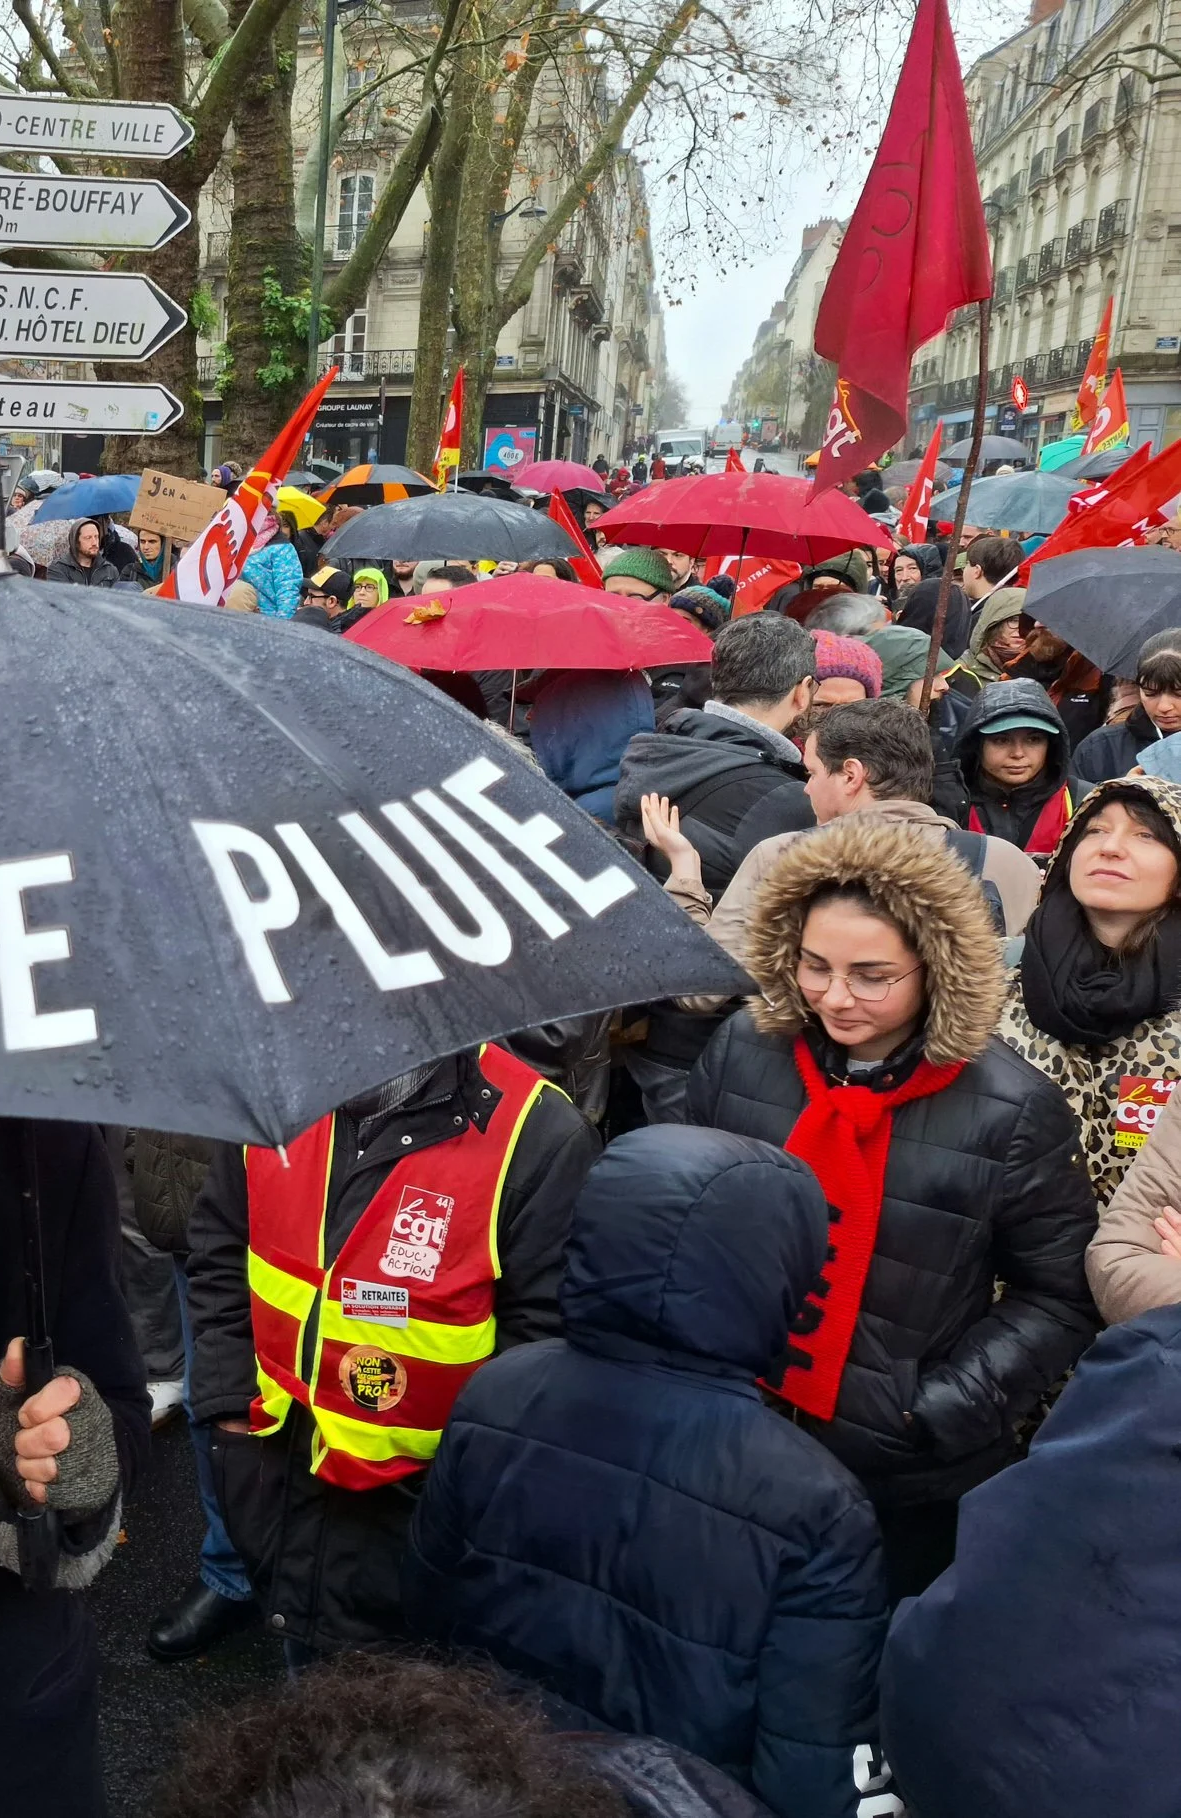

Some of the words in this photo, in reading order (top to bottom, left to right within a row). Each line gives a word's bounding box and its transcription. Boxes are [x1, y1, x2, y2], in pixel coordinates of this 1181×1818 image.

[111, 121, 165, 144] VILLE
[16, 314, 86, 344] HÔTEL
[93, 323, 145, 345] DIEU
[190, 756, 638, 1004] PLUIE
[1120, 1083, 1167, 1105] la
[1116, 1101, 1164, 1132] cg
[400, 1198, 435, 1222] la
[436, 1197, 449, 1208] 44
[394, 1213, 446, 1246] cgt
[361, 1290, 406, 1302] RETRAITES
[356, 1357, 381, 1367] NON
